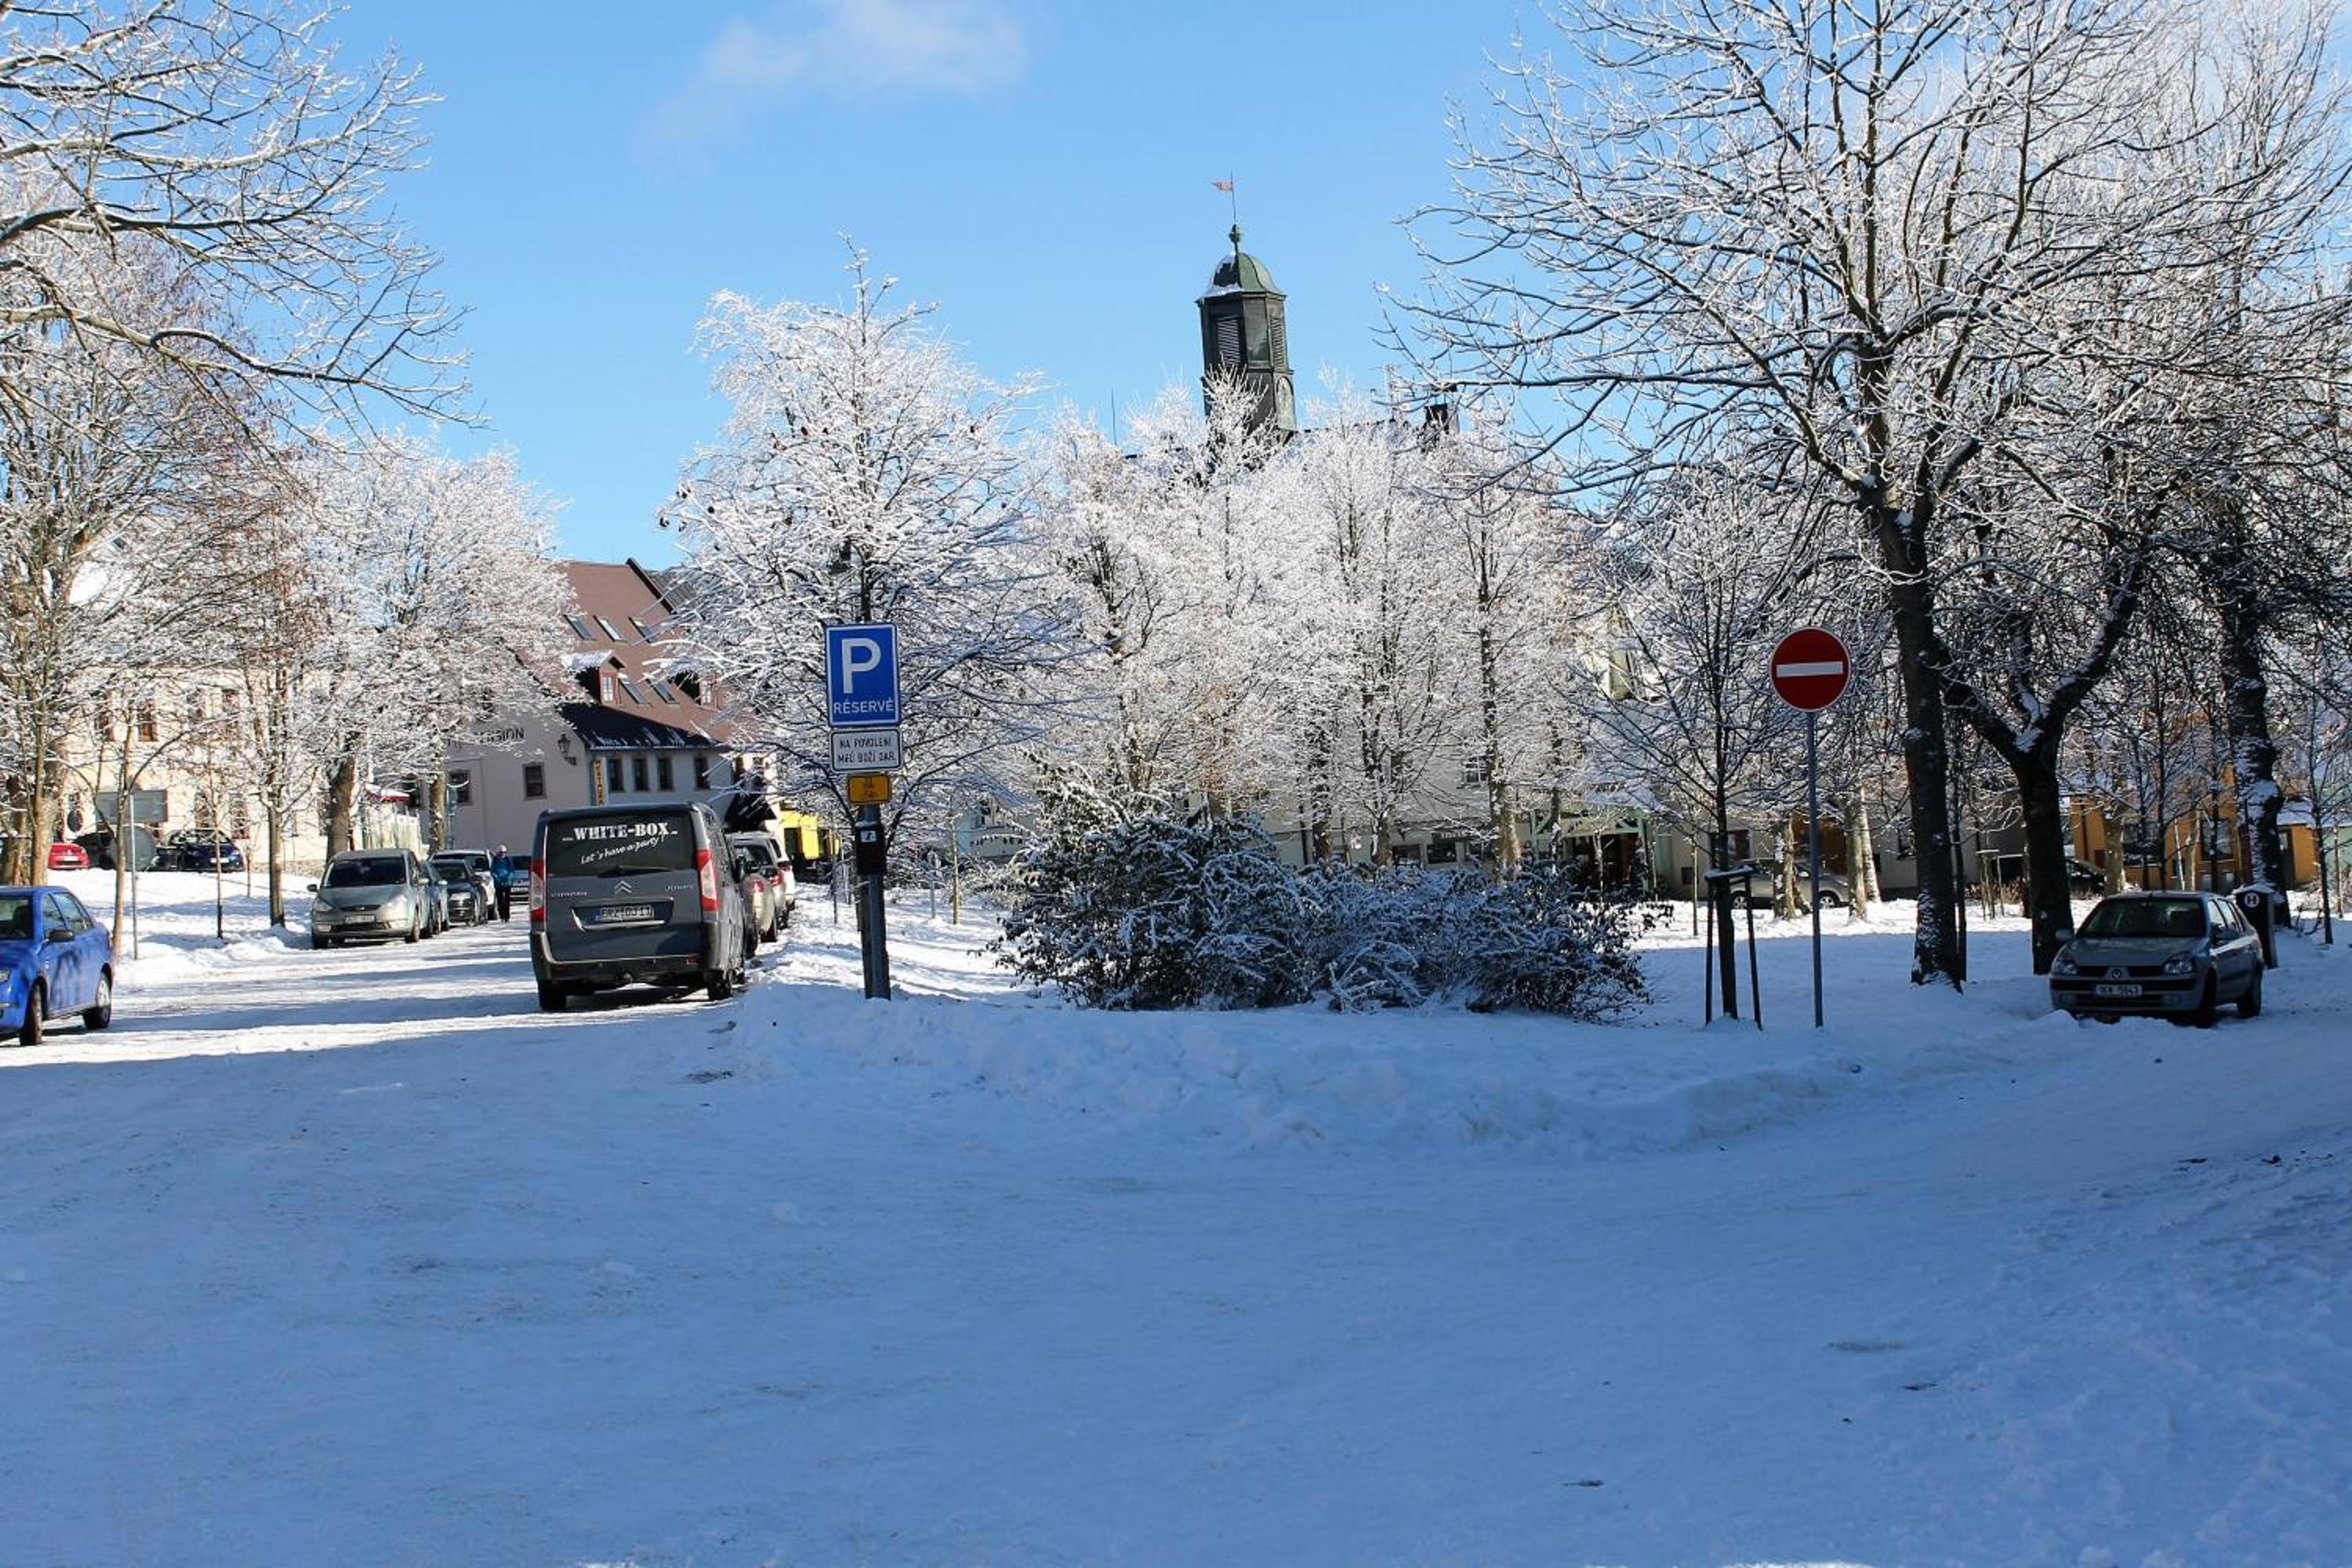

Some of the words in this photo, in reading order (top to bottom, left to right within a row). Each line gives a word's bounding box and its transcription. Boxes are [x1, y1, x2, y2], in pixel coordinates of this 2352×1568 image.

[841, 637, 881, 694] P
[833, 697, 895, 714] RÉSERVÉ
[840, 739, 851, 749] NA
[604, 848, 626, 858] have
